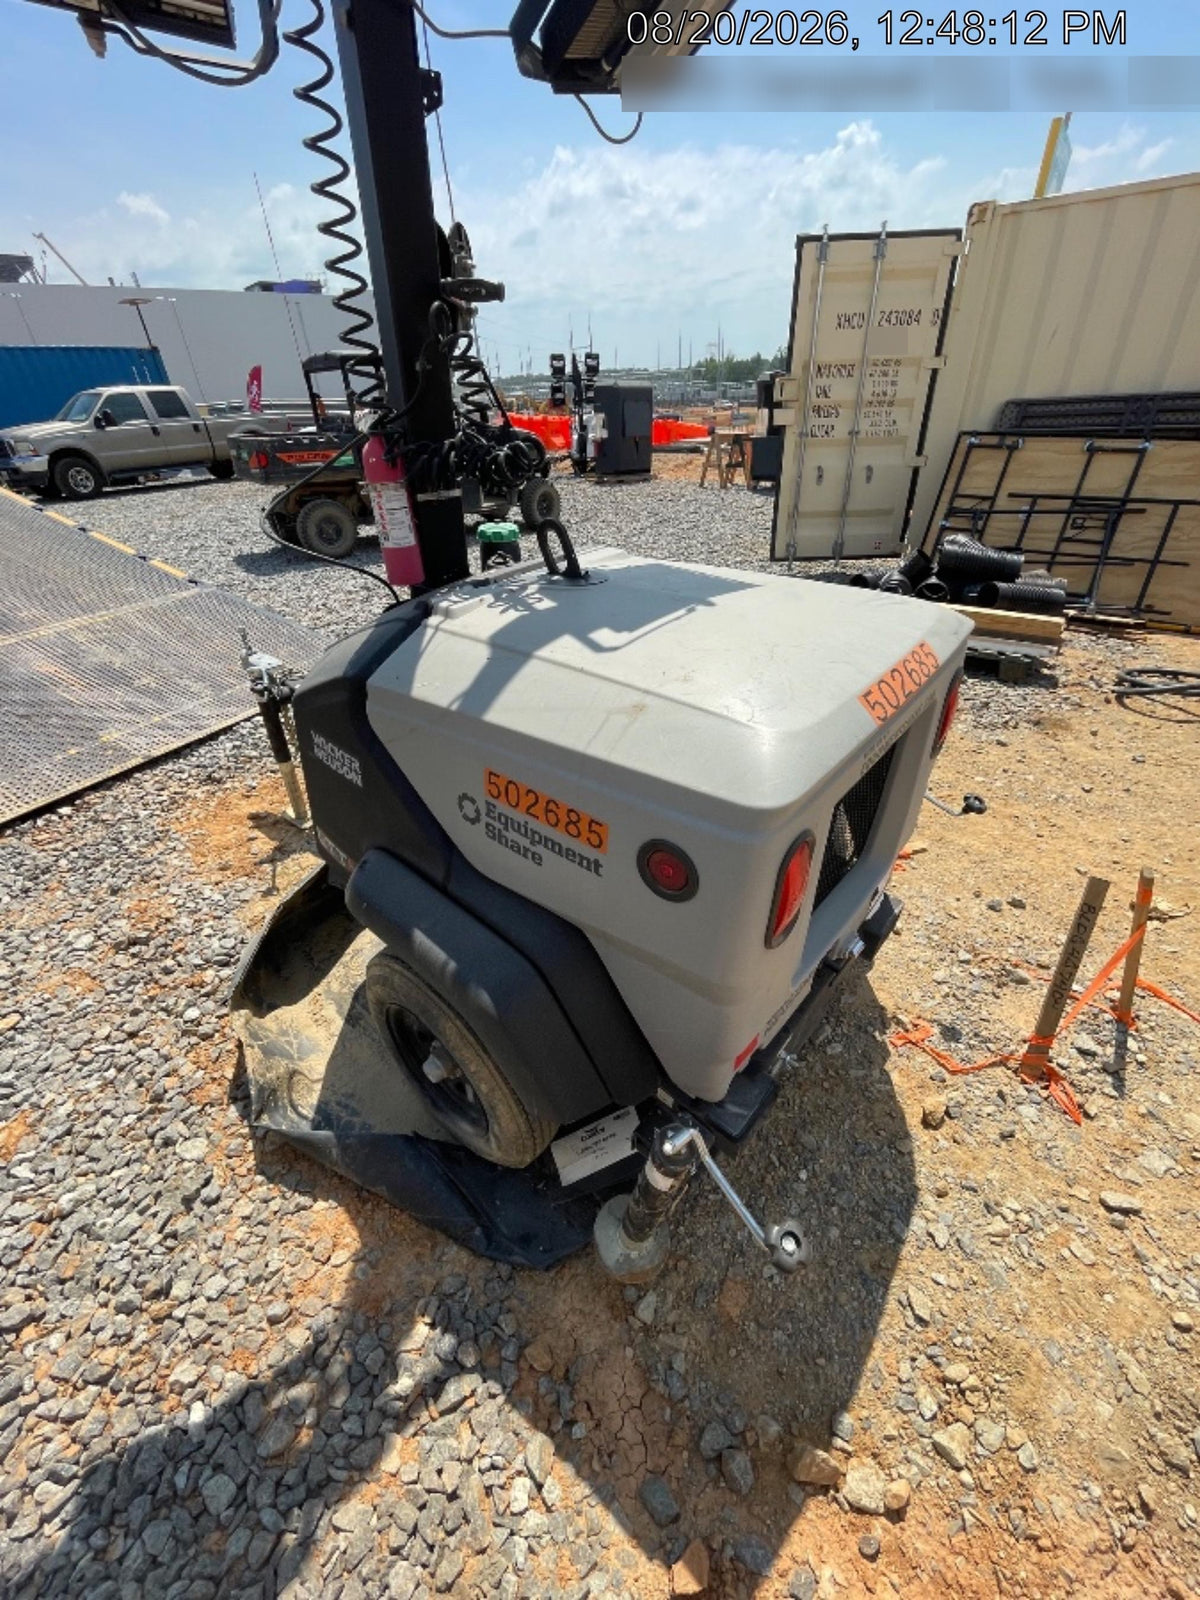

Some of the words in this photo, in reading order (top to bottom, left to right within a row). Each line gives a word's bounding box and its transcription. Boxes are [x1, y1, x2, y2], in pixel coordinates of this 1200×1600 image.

[878, 309, 922, 327] 243084
[861, 643, 940, 722] 502685
[484, 799, 604, 877] Equipment
[484, 823, 543, 867] Share
[487, 770, 604, 849] 502685
